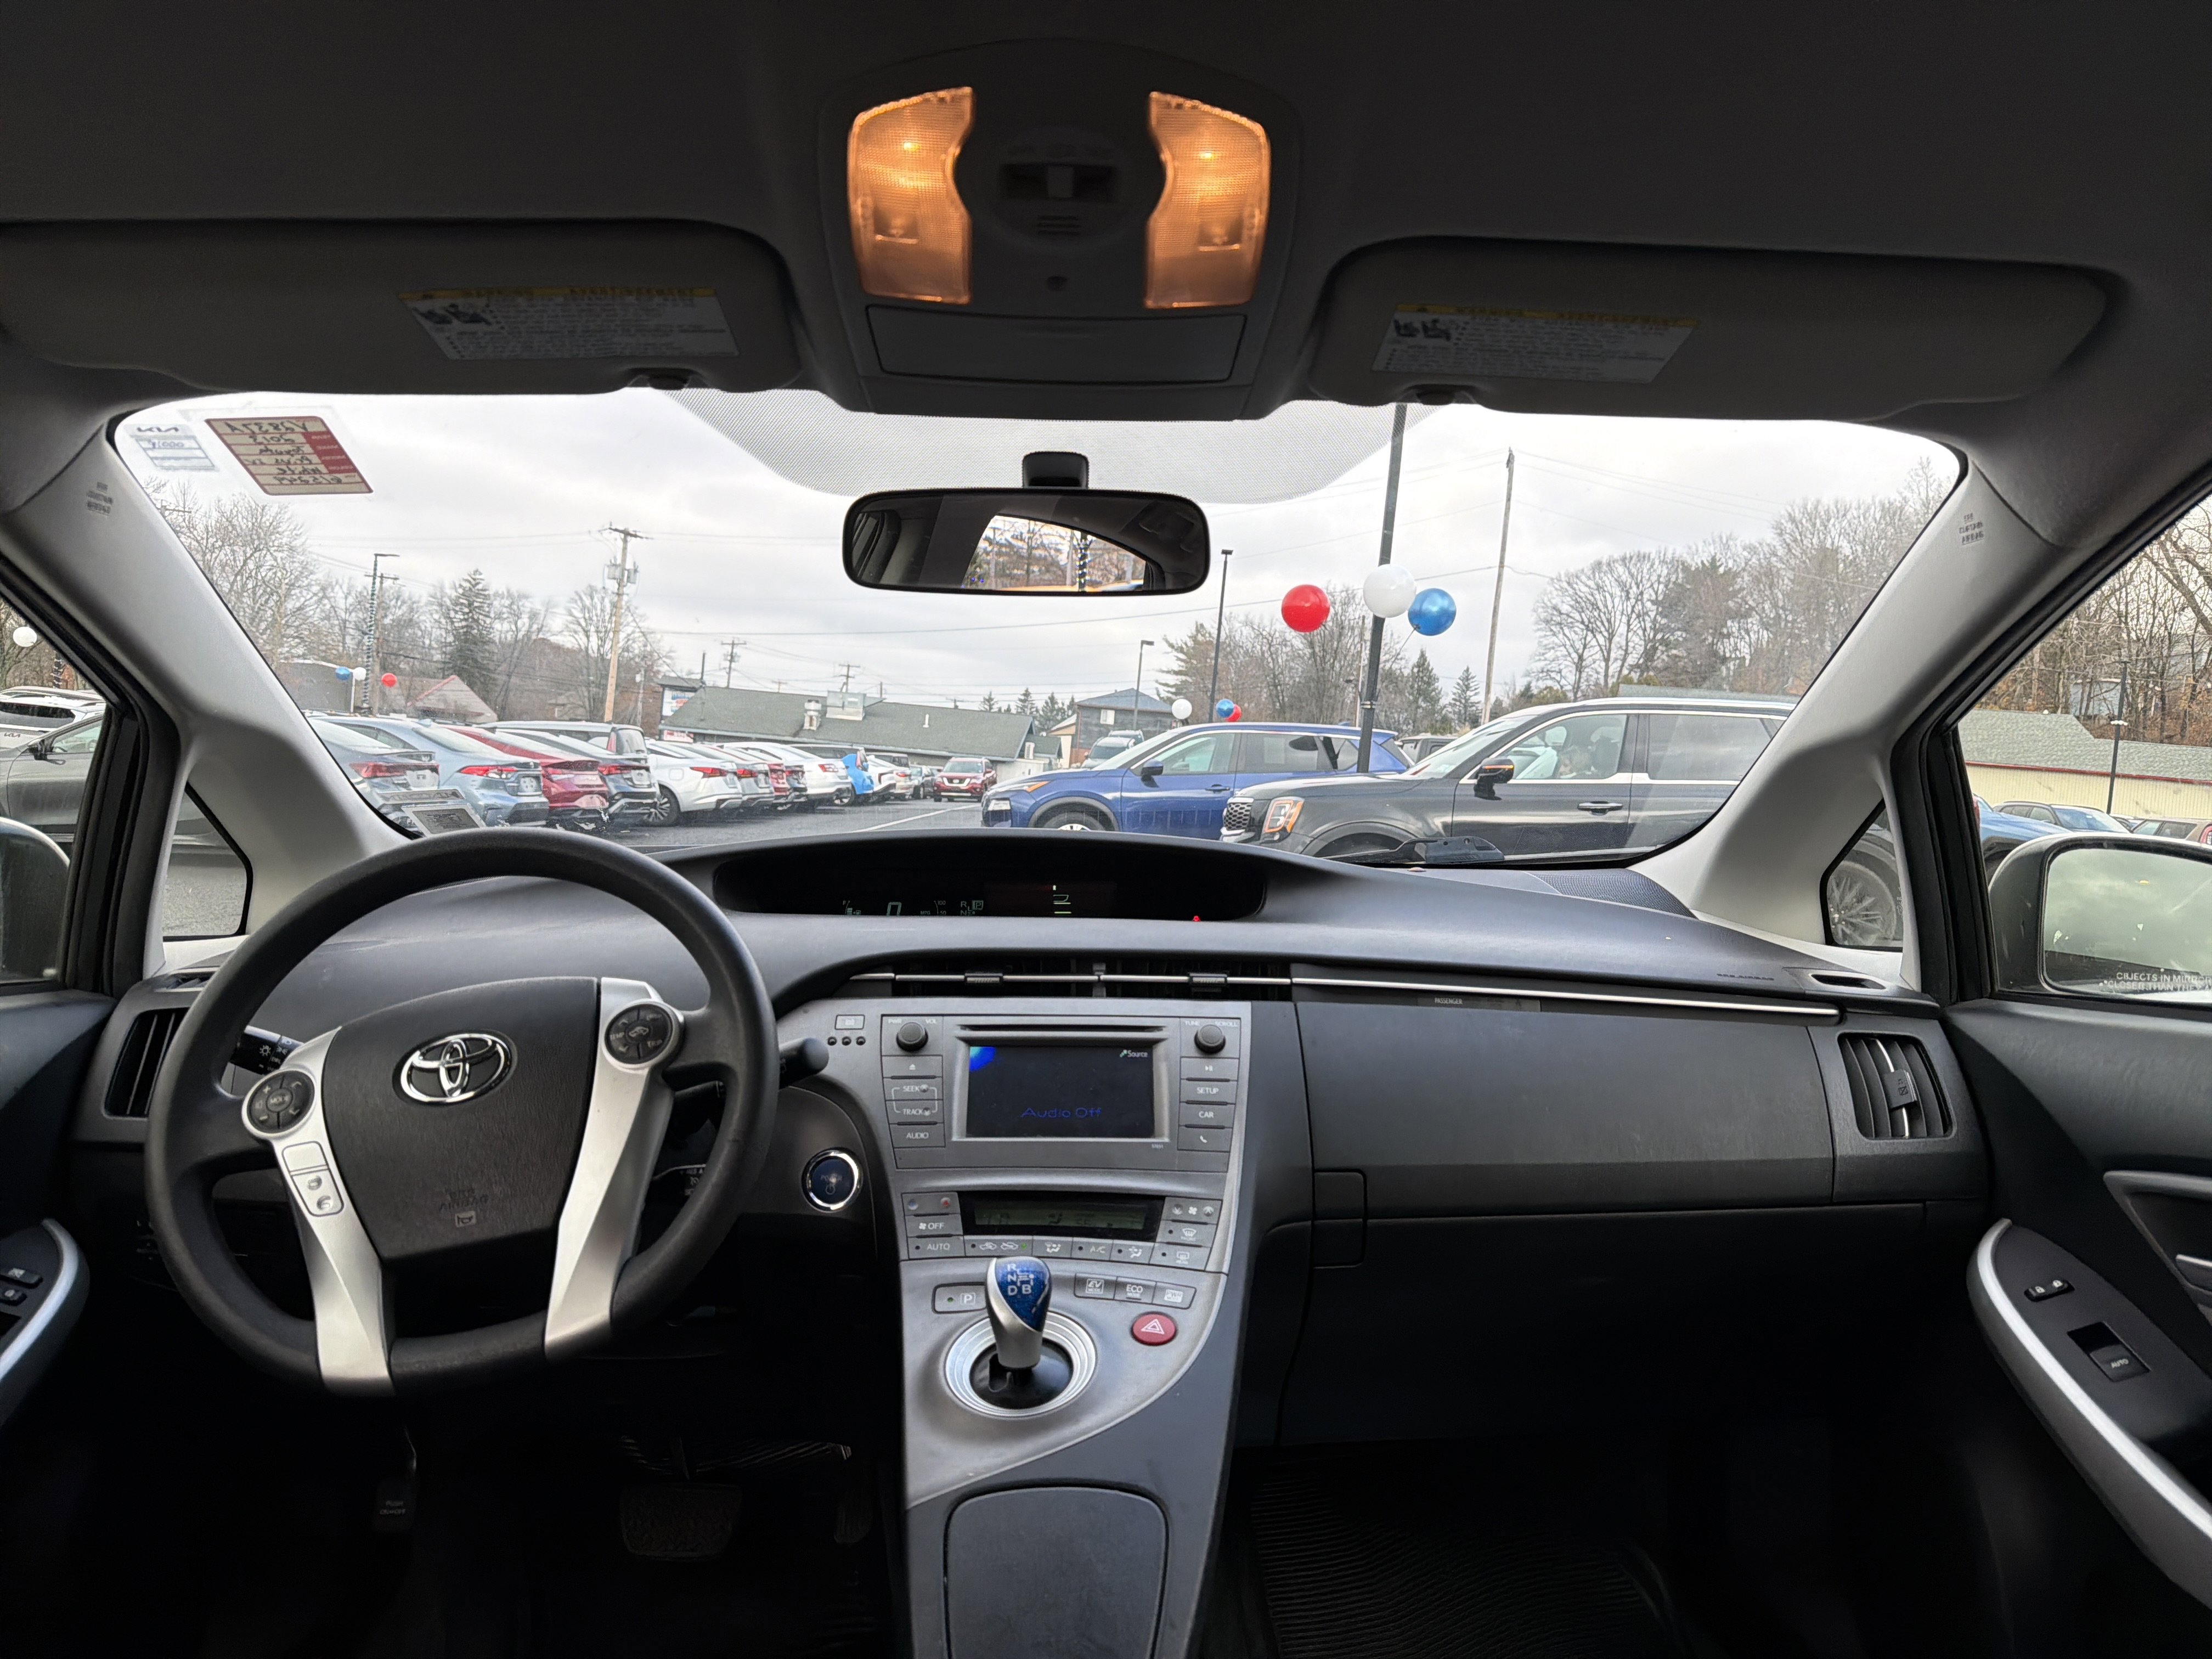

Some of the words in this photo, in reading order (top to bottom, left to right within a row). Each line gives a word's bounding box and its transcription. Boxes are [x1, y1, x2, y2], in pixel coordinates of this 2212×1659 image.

[1020, 1107, 1071, 1118] Audio
[1076, 1107, 1102, 1118] Off
[1198, 1110, 1214, 1119] CAR
[927, 1243, 950, 1251] AUTO
[1007, 1263, 1017, 1272] R
[1007, 1273, 1017, 1282] N
[1008, 1285, 1018, 1296] D
[1022, 1284, 1032, 1294] B
[1126, 1284, 1143, 1293] ECO
[2111, 1358, 2129, 1369] AUTO
